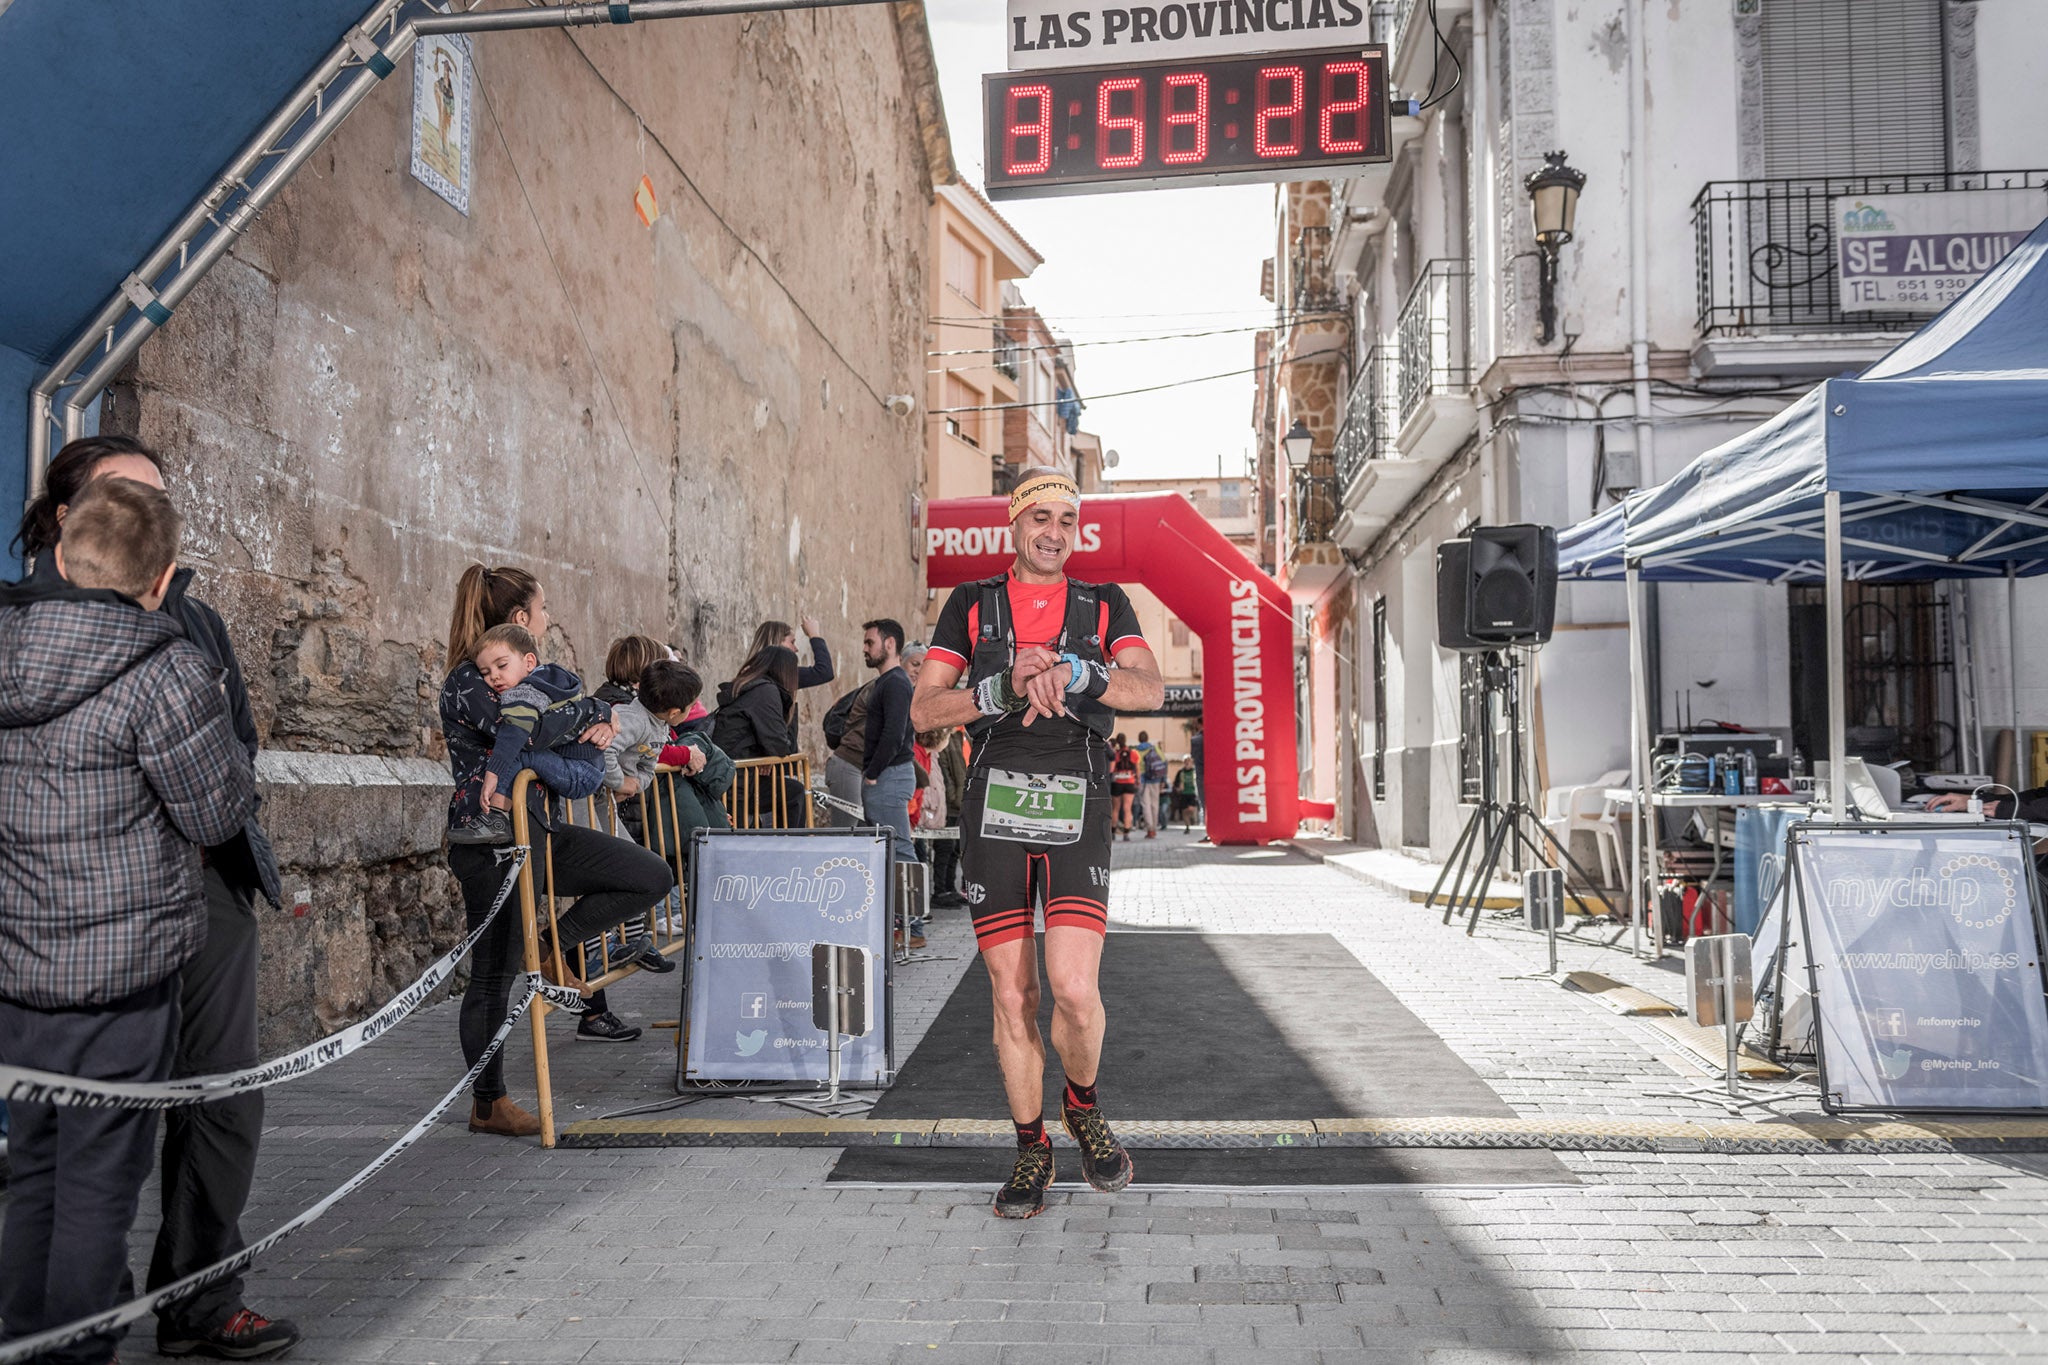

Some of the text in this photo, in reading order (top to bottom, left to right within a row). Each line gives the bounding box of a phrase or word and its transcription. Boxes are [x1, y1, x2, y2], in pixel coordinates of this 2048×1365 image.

[1013, 0, 1363, 52] LAS PROVINCIAS
[1847, 240, 1888, 273] SE
[1897, 280, 1927, 290] 651
[1935, 279, 1966, 289] 930
[1897, 292, 1929, 302] 964
[926, 523, 1102, 556] PROVIS
[1230, 580, 1268, 824] LAS PROVINCIAS
[1014, 790, 1055, 811] 711
[713, 867, 846, 912] mychip
[1827, 867, 1981, 916] mychip
[710, 939, 816, 962] www.myc
[1832, 948, 2020, 975] www.mychip.es
[775, 1000, 813, 1013] /infomy
[1916, 1016, 1982, 1028] /infomychip
[773, 1037, 829, 1049] @Mychip_I
[1920, 1059, 2000, 1071] @Mychip_Info
